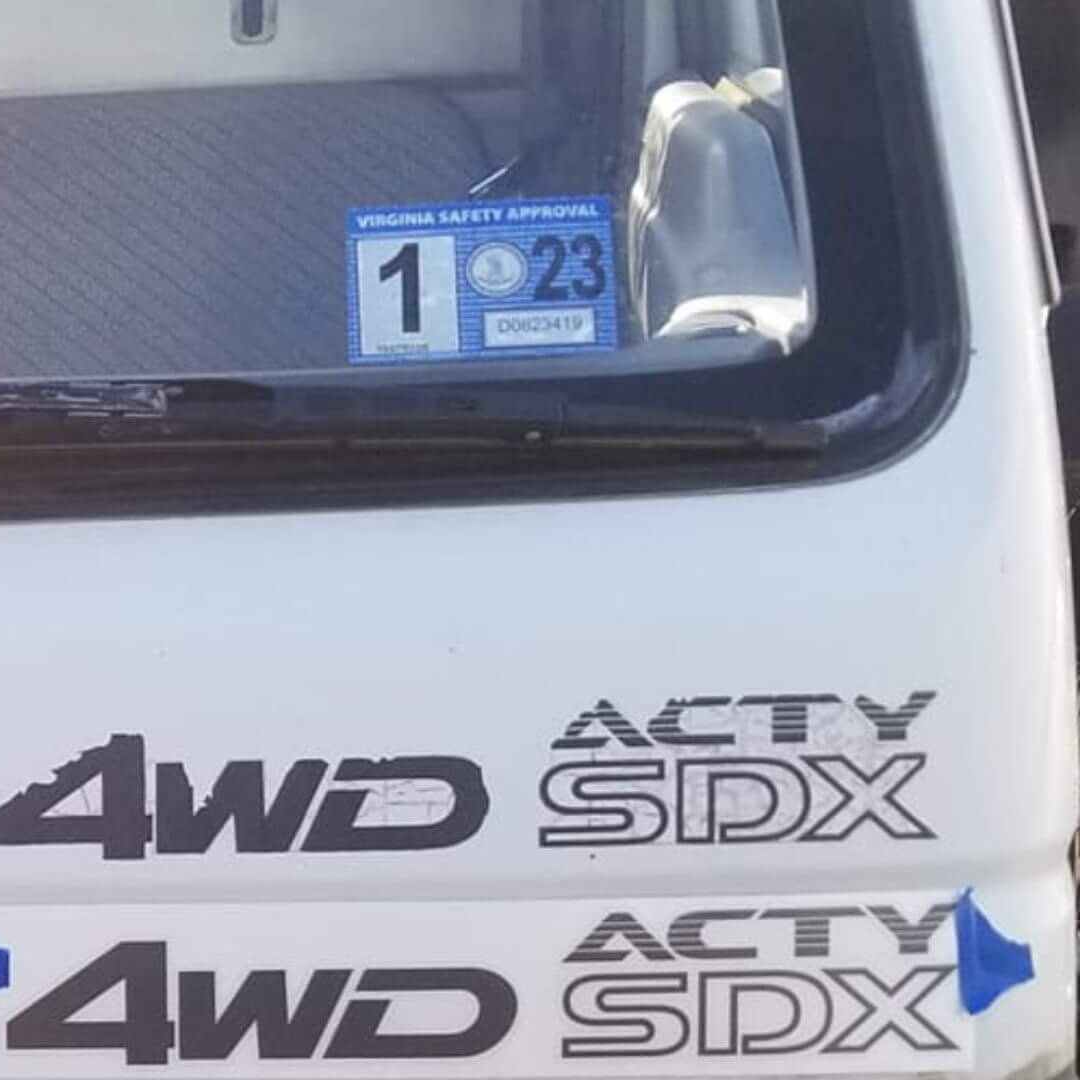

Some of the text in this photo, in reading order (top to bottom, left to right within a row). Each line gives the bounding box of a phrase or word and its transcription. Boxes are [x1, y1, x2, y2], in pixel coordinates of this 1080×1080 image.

[356, 202, 599, 229] VIRGINIA SAFETY APPROVAL
[378, 242, 420, 334] 1
[532, 234, 606, 301] 23
[551, 691, 937, 749] ACTY
[538, 753, 937, 847] SDX
[562, 903, 958, 963] ACTY
[6, 940, 518, 1065] 4WD
[561, 965, 960, 1058] SDX
